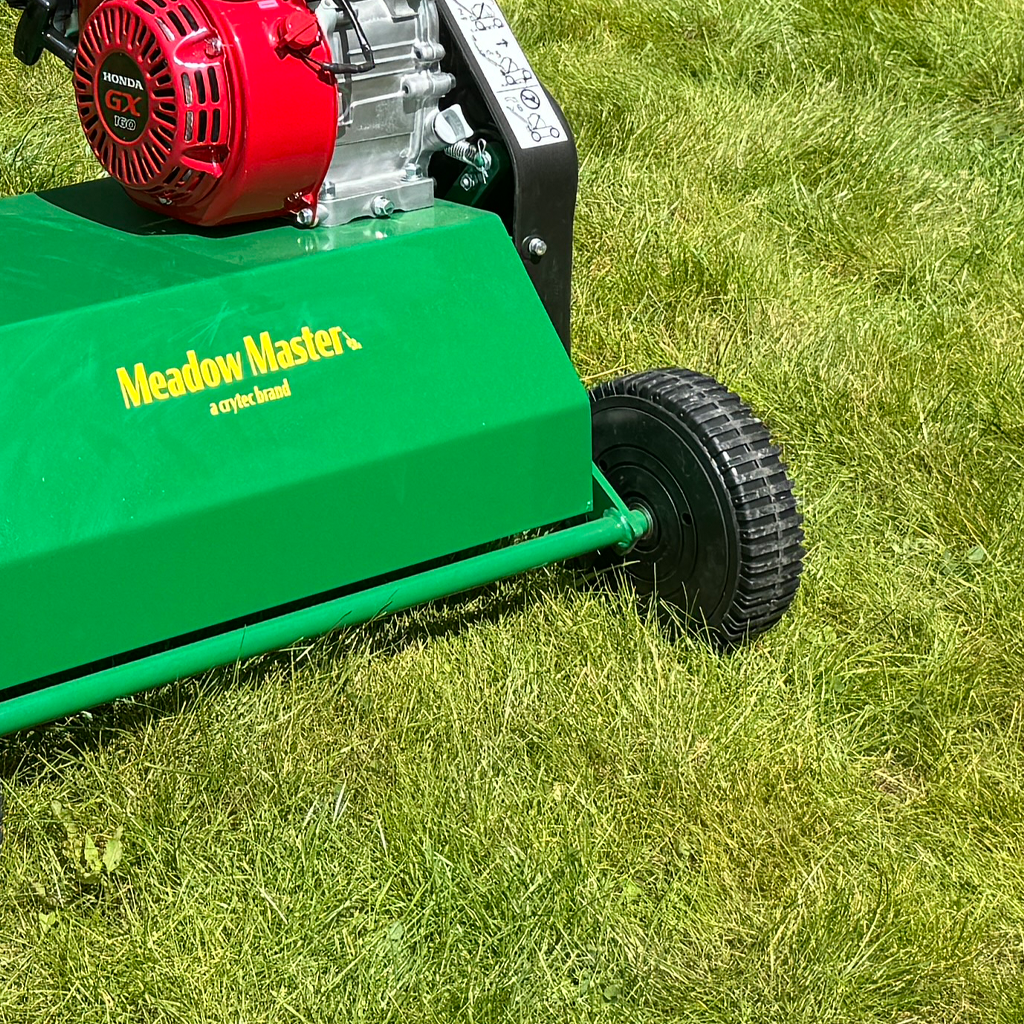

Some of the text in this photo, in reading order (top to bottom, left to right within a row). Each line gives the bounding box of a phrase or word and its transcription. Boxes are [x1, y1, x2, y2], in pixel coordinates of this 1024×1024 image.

[102, 71, 144, 91] HONDA
[105, 89, 142, 117] GX
[114, 115, 137, 131] 160
[116, 326, 344, 409] Meadow Master
[210, 378, 292, 416] a crytec brand
